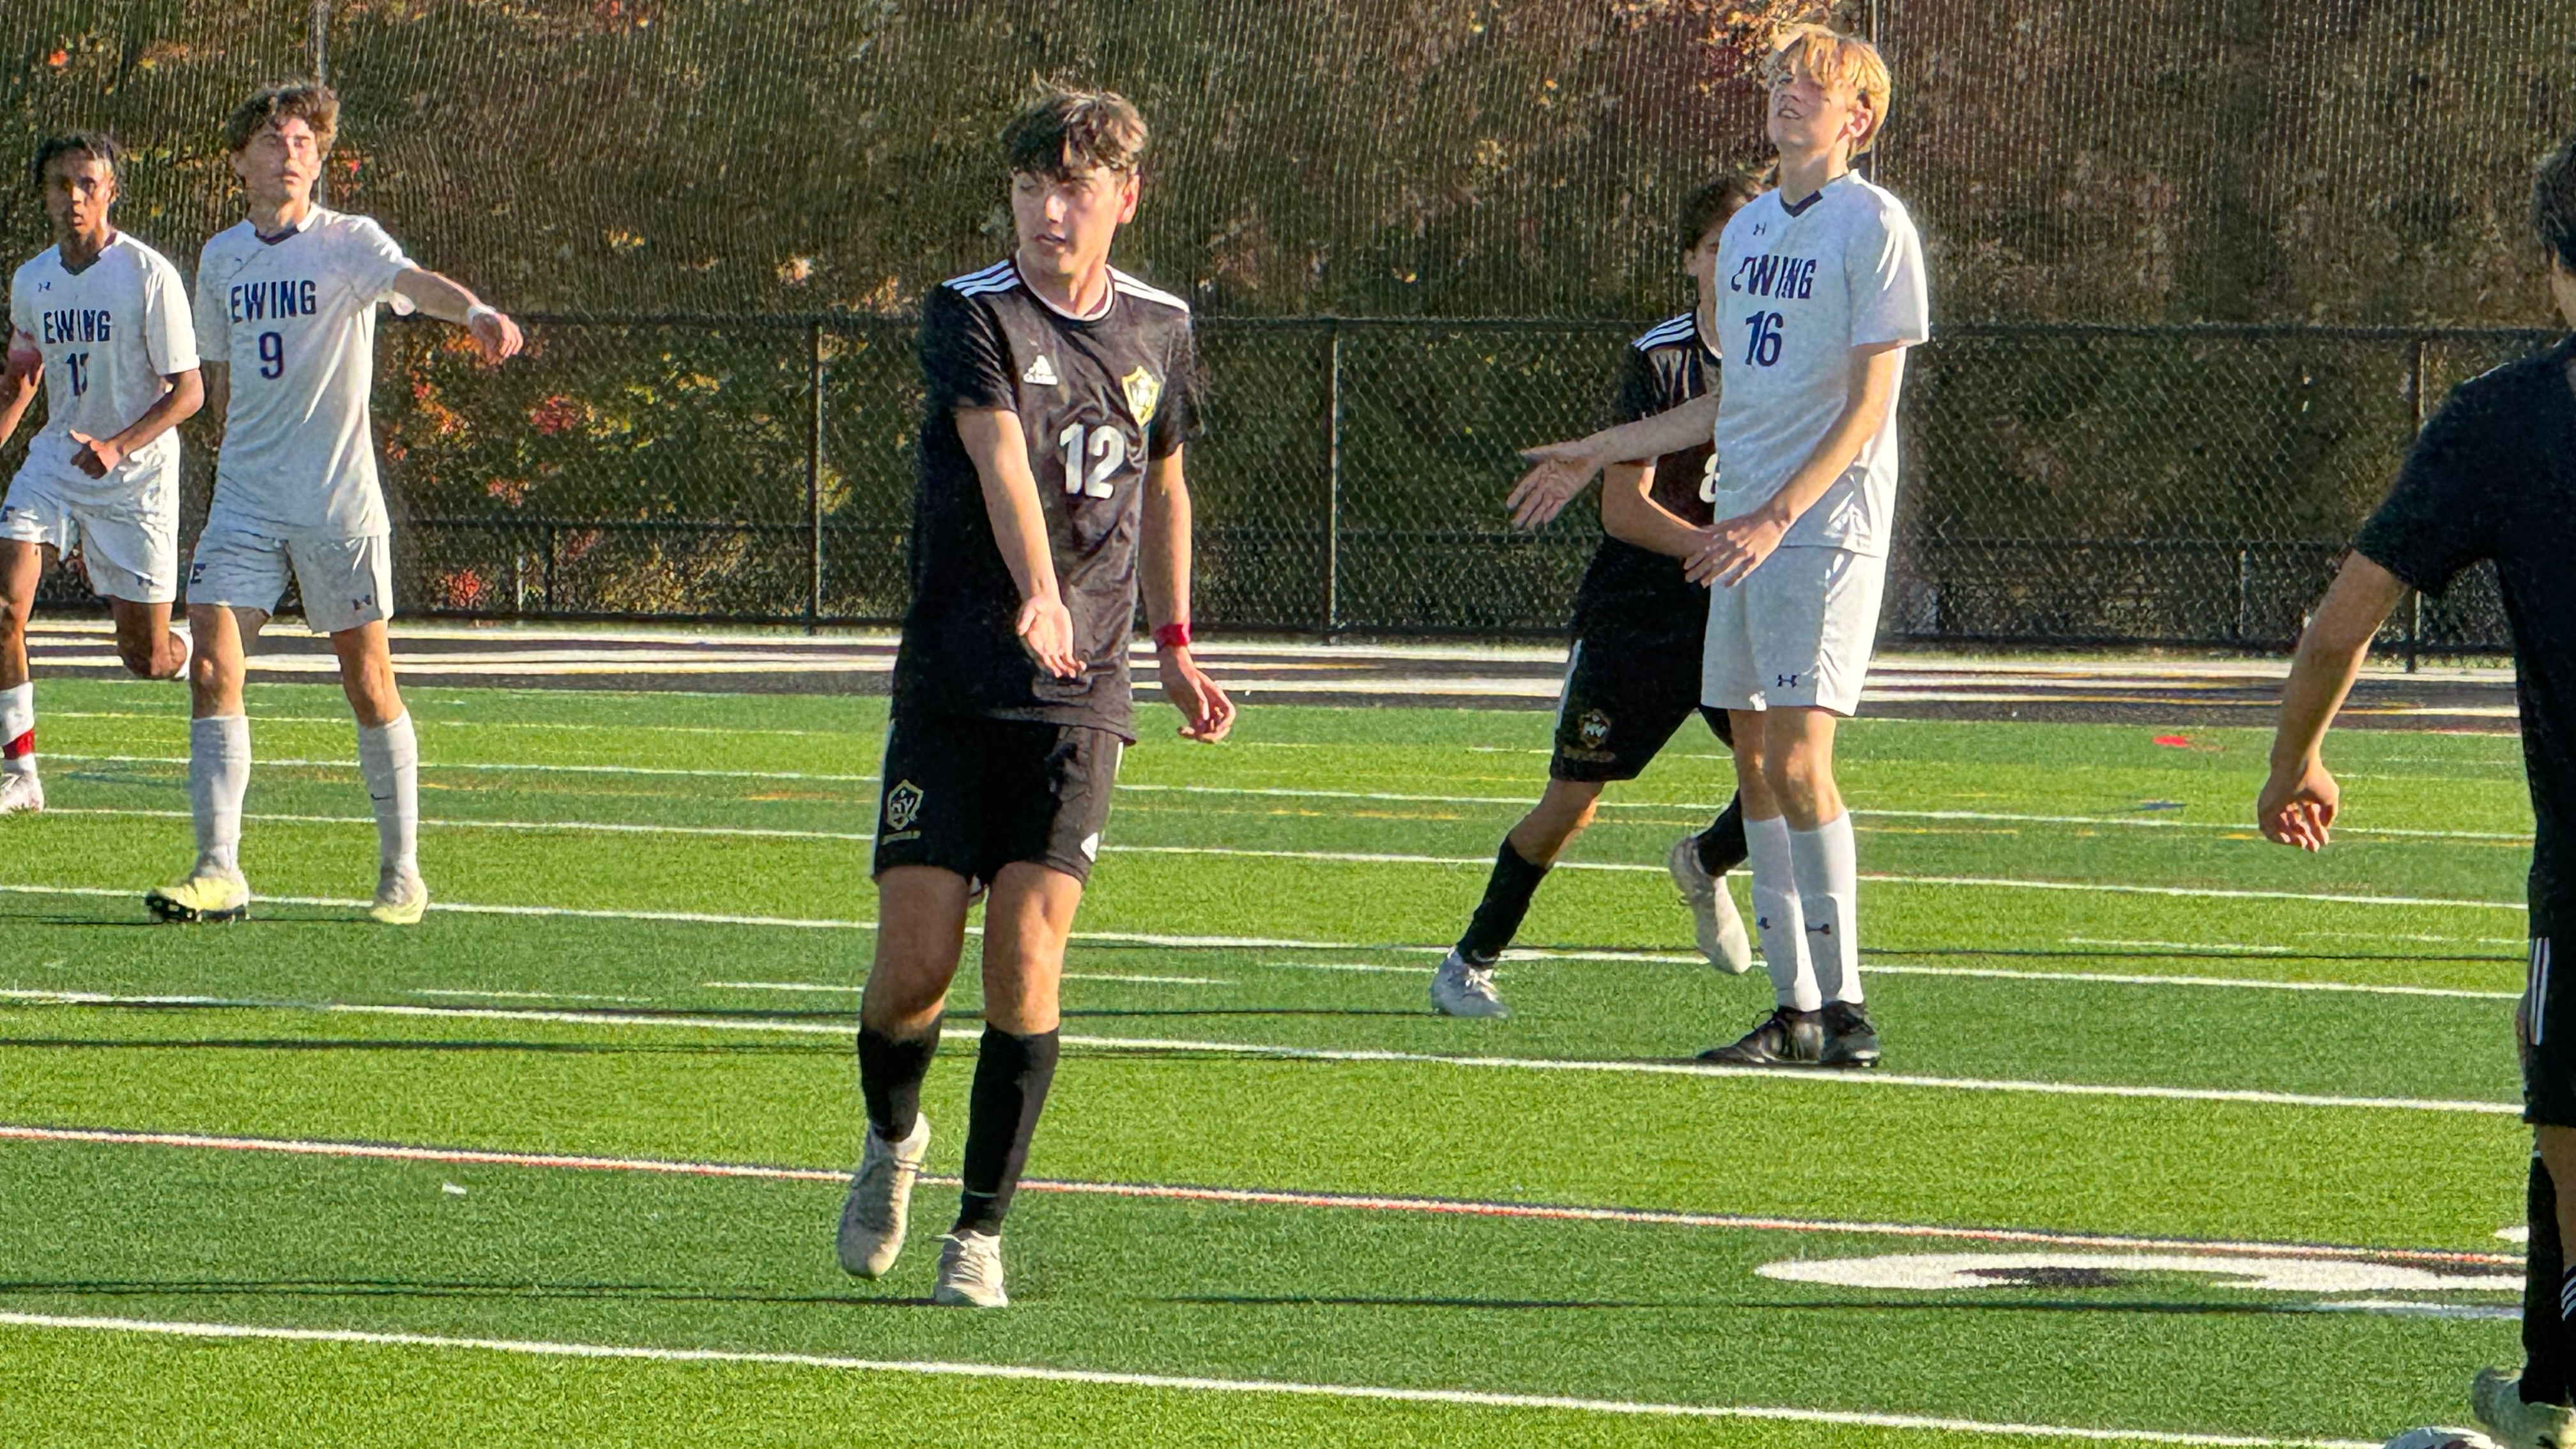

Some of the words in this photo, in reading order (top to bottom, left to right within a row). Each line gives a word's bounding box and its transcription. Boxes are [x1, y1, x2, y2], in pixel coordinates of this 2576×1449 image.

[1731, 254, 1817, 299] EWING
[231, 280, 317, 323] EWING
[44, 309, 111, 344] EWING
[1745, 310, 1784, 367] 16
[259, 332, 284, 379] 9
[1059, 421, 1124, 499] 12
